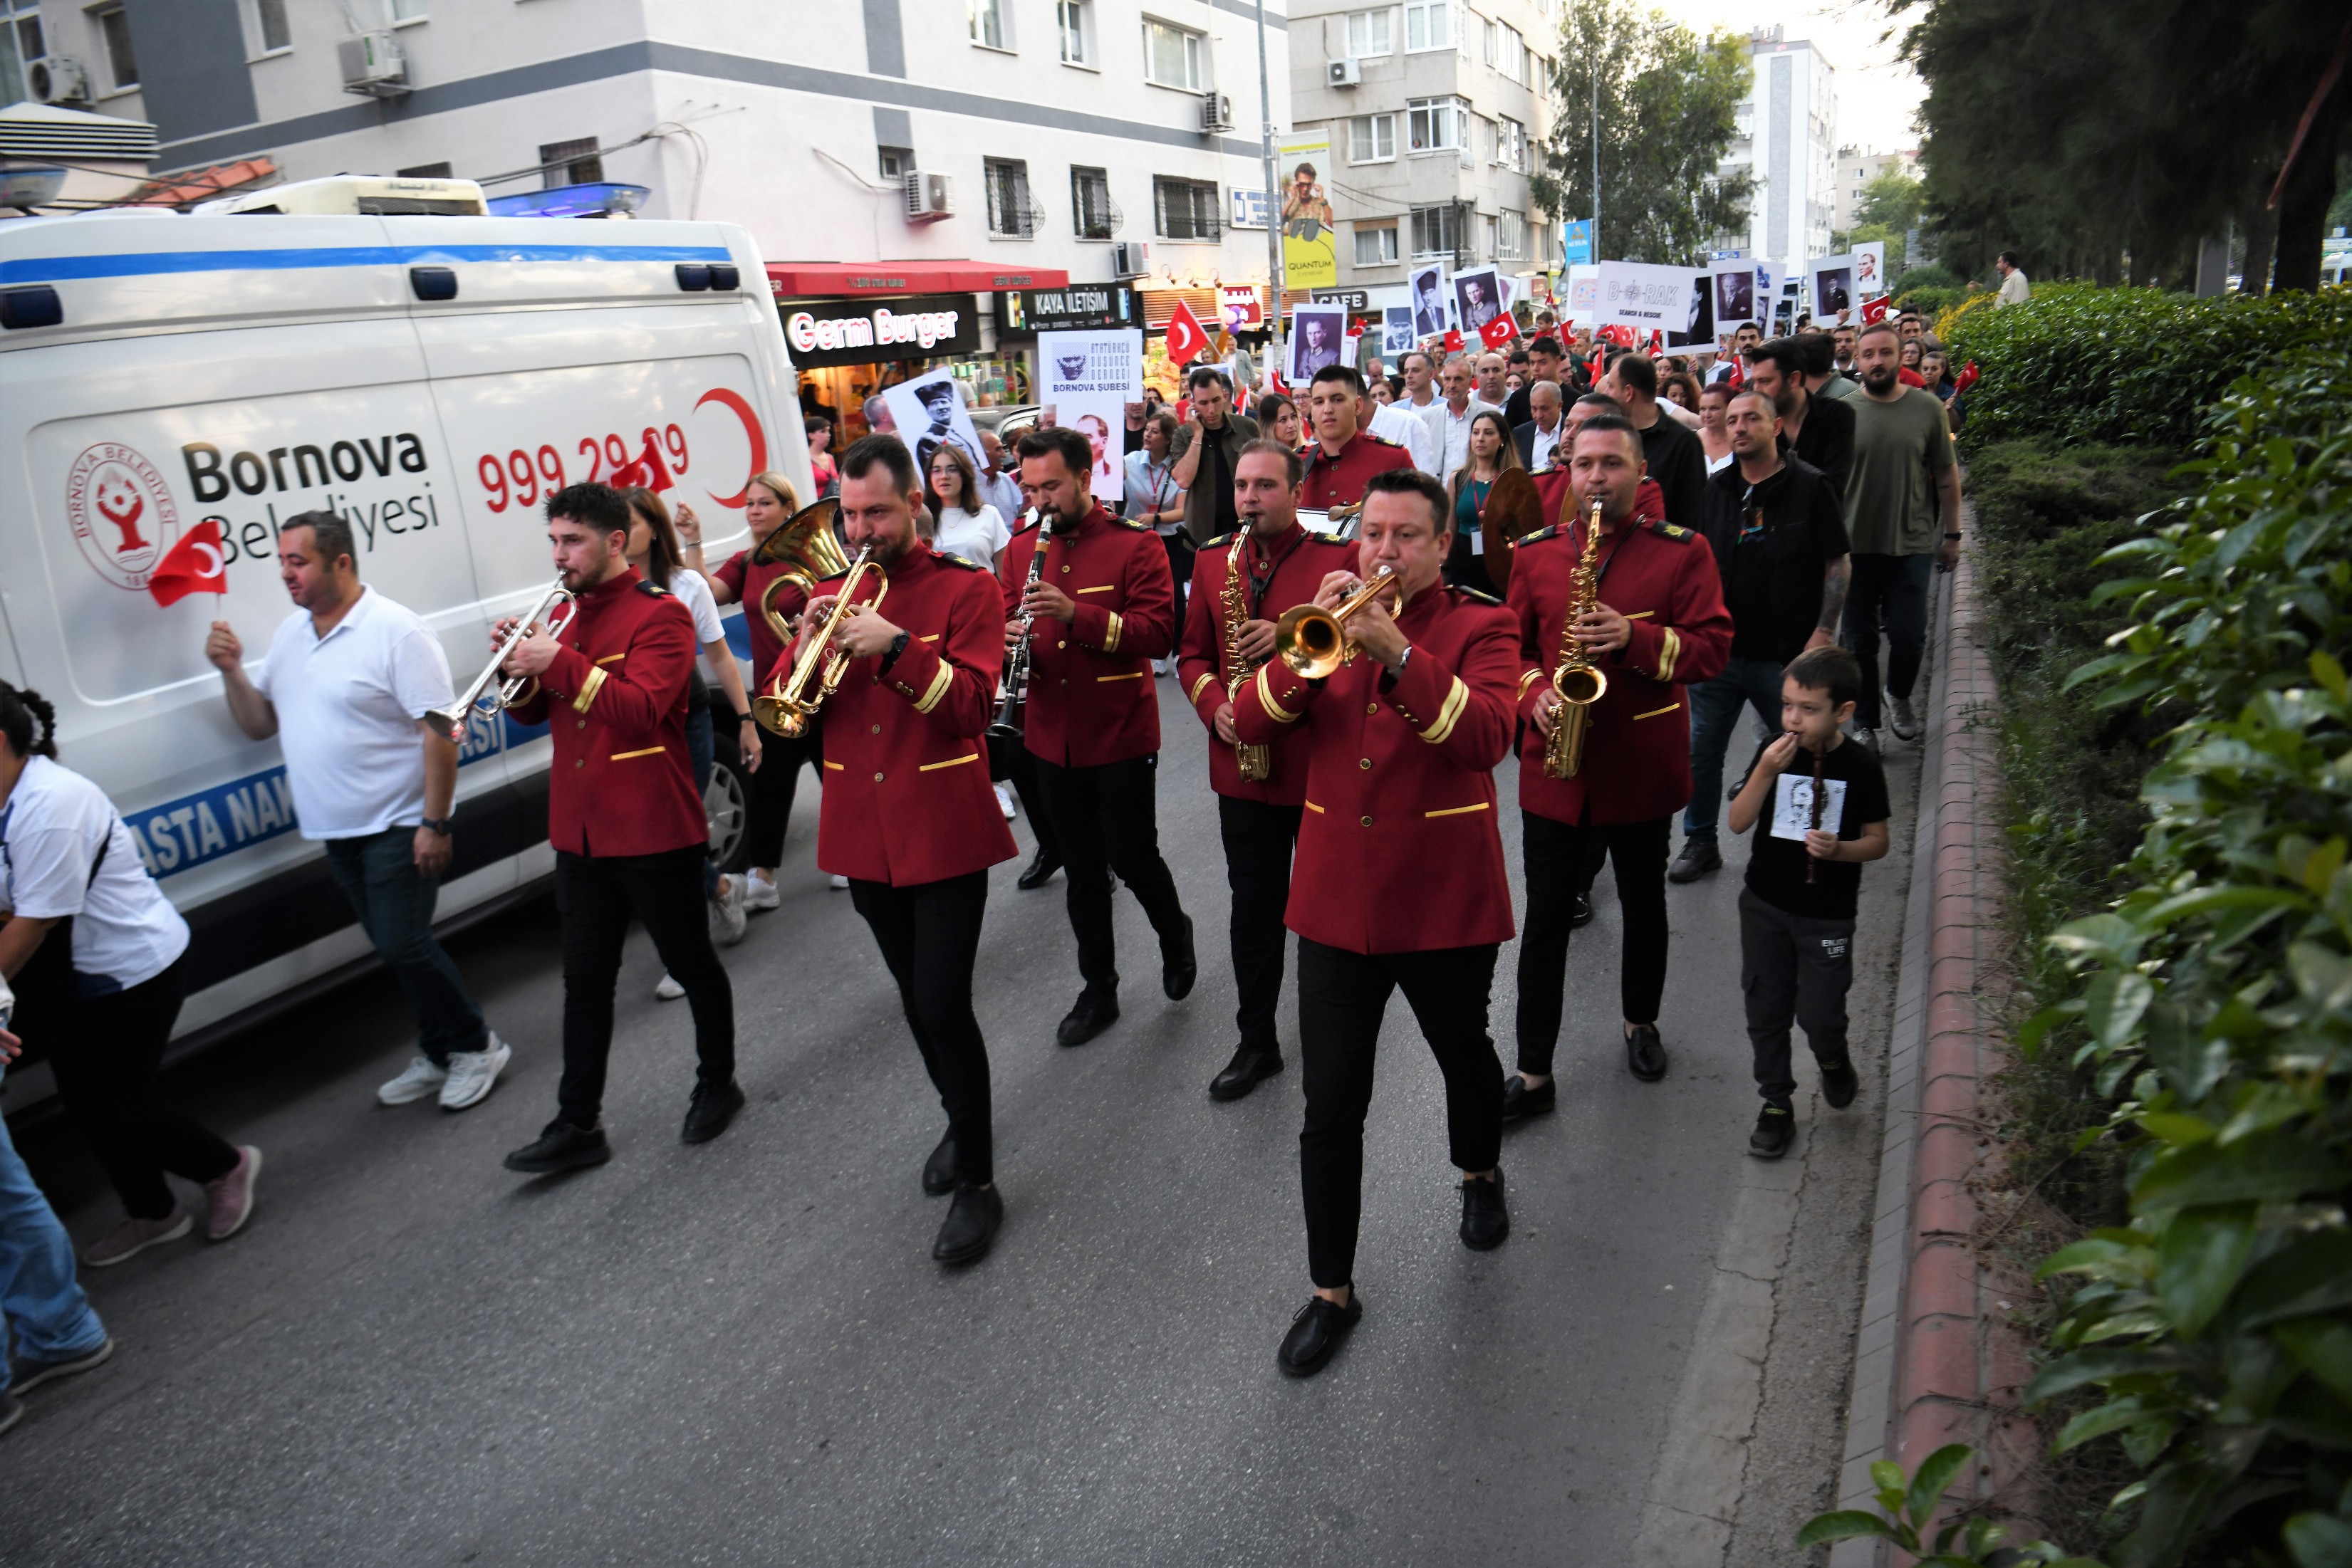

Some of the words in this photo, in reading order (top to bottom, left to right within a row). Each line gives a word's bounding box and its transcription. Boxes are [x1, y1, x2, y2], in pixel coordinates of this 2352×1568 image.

[1289, 261, 1332, 271] QUANTUM
[1035, 293, 1066, 315] KAYA
[1066, 286, 1109, 315] İLETİŞİM
[788, 312, 874, 352] Germ
[875, 308, 959, 349] Burger
[1053, 384, 1095, 392] BORNOVA
[1098, 380, 1130, 392] ŞUBESİ
[69, 452, 101, 538] BORNOVA
[182, 432, 428, 503] Bornova
[478, 444, 566, 513] 999
[201, 481, 439, 565] Beliyesi
[128, 800, 228, 875] ASTA
[1827, 946, 1845, 955] LIFE
